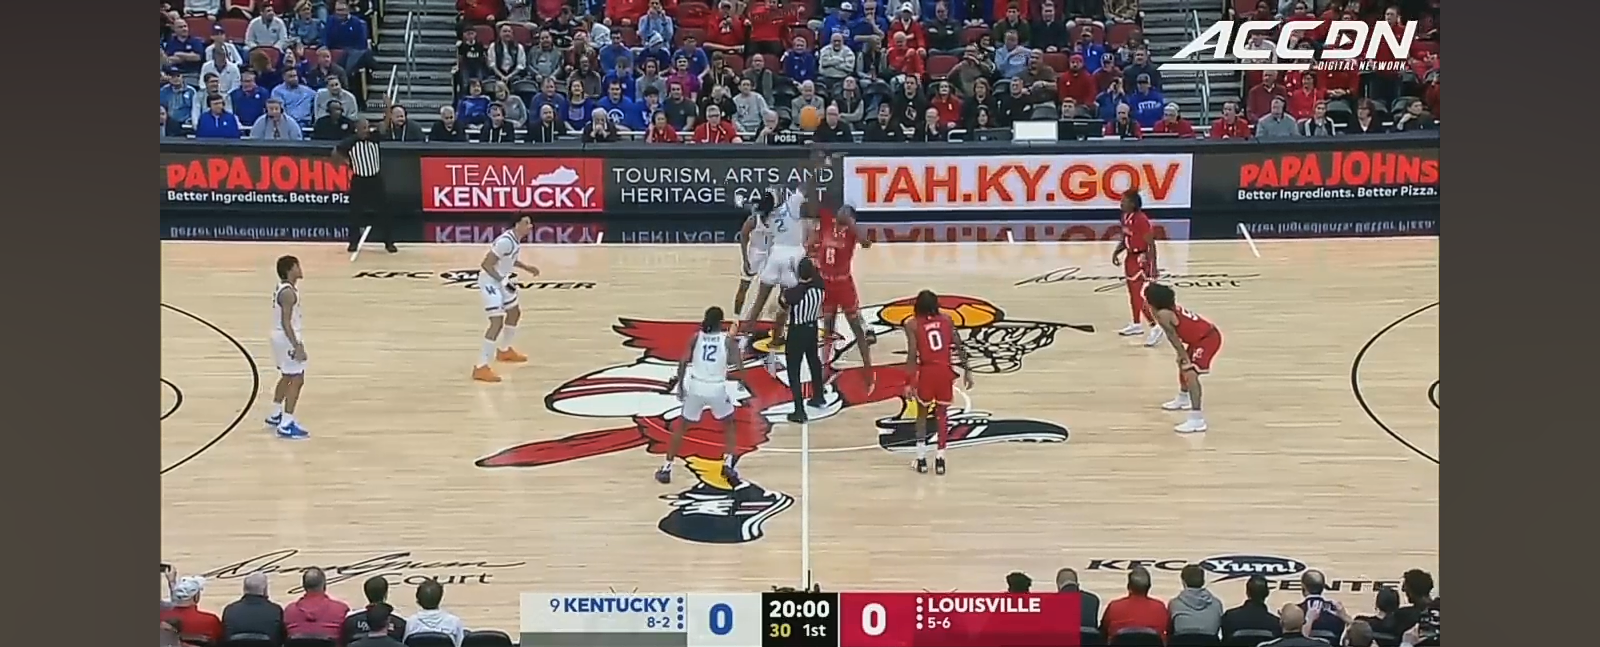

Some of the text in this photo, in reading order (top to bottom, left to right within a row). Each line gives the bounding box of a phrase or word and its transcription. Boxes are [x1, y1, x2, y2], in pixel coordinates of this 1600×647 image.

[774, 134, 797, 143] POSS
[167, 155, 352, 191] PAPA JOHN
[445, 164, 525, 186] TEAM
[612, 167, 717, 185] TOURISM,
[724, 167, 780, 184] ARTS
[1239, 151, 1439, 188] PAPA JOHNS
[855, 163, 1180, 203] TAH.KY.GOV
[167, 190, 208, 201] Better
[211, 191, 288, 203] Ingredients.
[290, 192, 330, 203] Better
[433, 186, 597, 208] KENTUCKY.
[621, 187, 726, 203] HERITAGE
[1237, 185, 1438, 200] Better Ingredients. Better Pizza.
[352, 271, 434, 279] KFC
[928, 329, 943, 351] 0
[702, 344, 717, 362] 12
[1087, 559, 1298, 573] KFC Yum!
